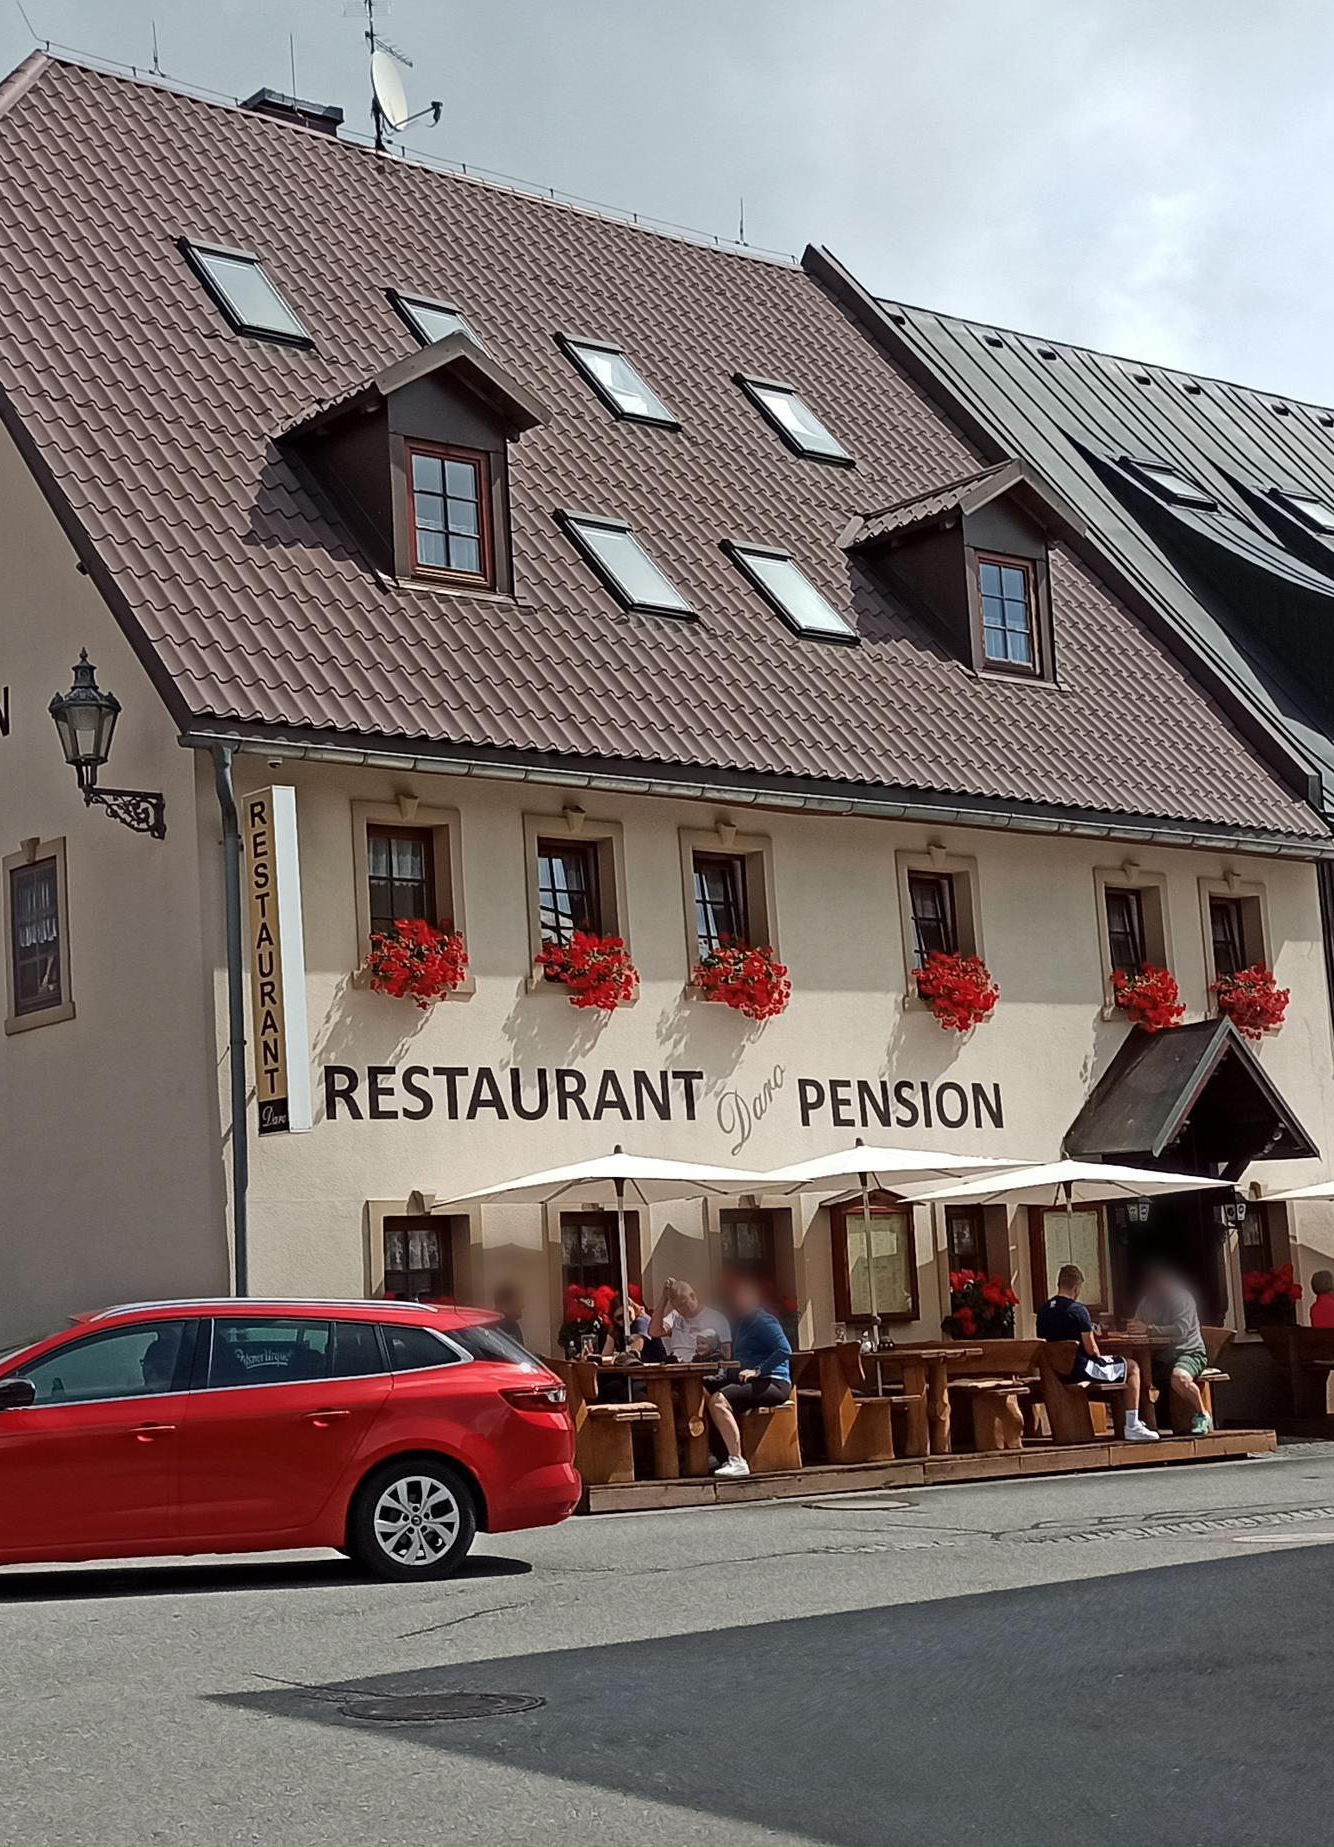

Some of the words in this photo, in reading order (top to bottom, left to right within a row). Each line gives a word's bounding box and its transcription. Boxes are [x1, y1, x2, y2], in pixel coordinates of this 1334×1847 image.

[249, 799, 280, 1095] RESTAURANT
[322, 1064, 704, 1122] RESTAURANT
[715, 1062, 786, 1157] Daro
[799, 1077, 1005, 1130] PENSION
